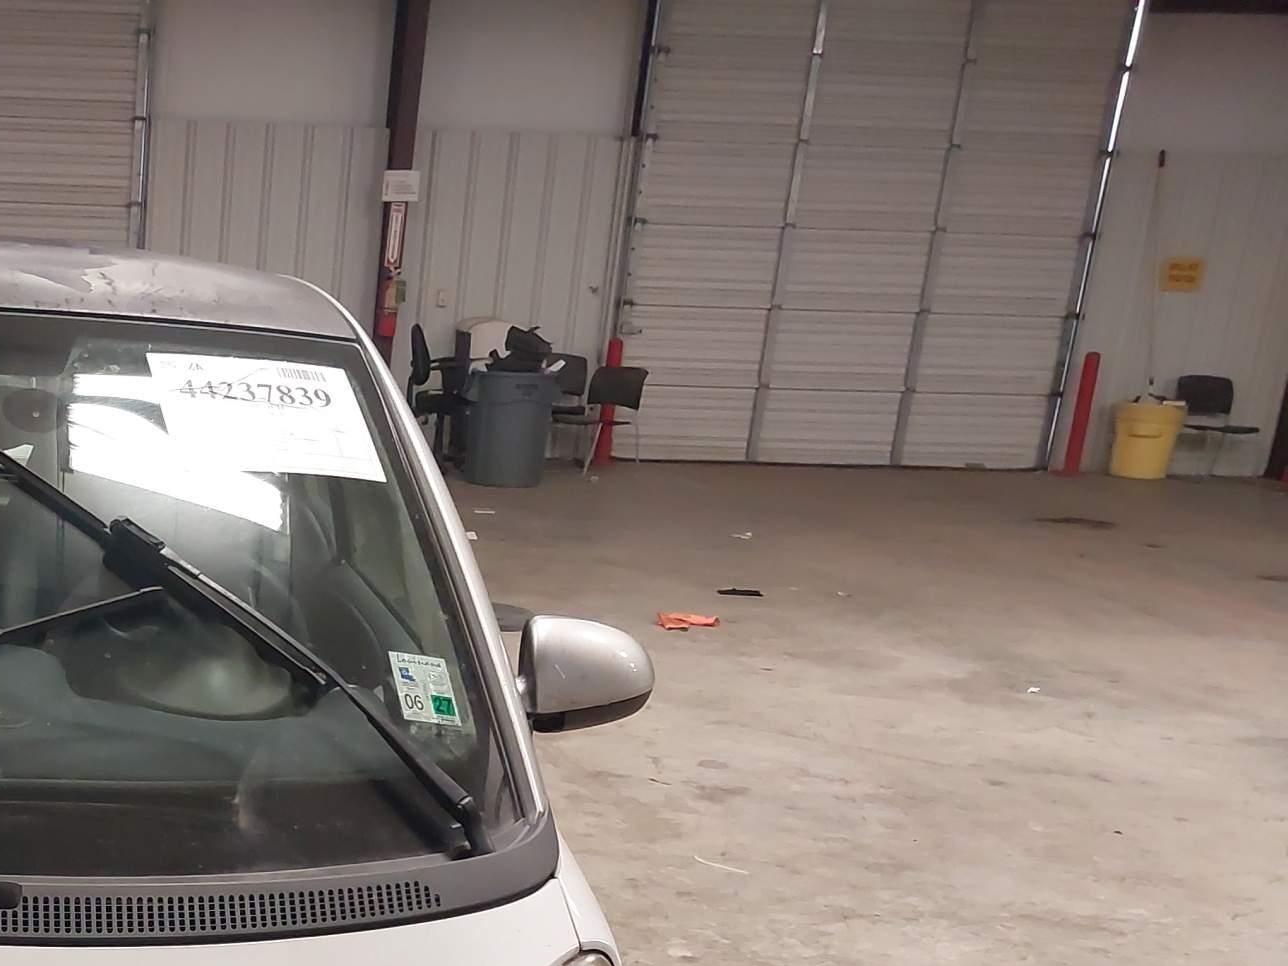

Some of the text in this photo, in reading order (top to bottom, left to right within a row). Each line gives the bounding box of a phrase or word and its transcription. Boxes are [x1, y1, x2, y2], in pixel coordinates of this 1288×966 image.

[178, 379, 333, 409] 44237839
[404, 693, 424, 711] 06
[433, 697, 454, 715] 27
